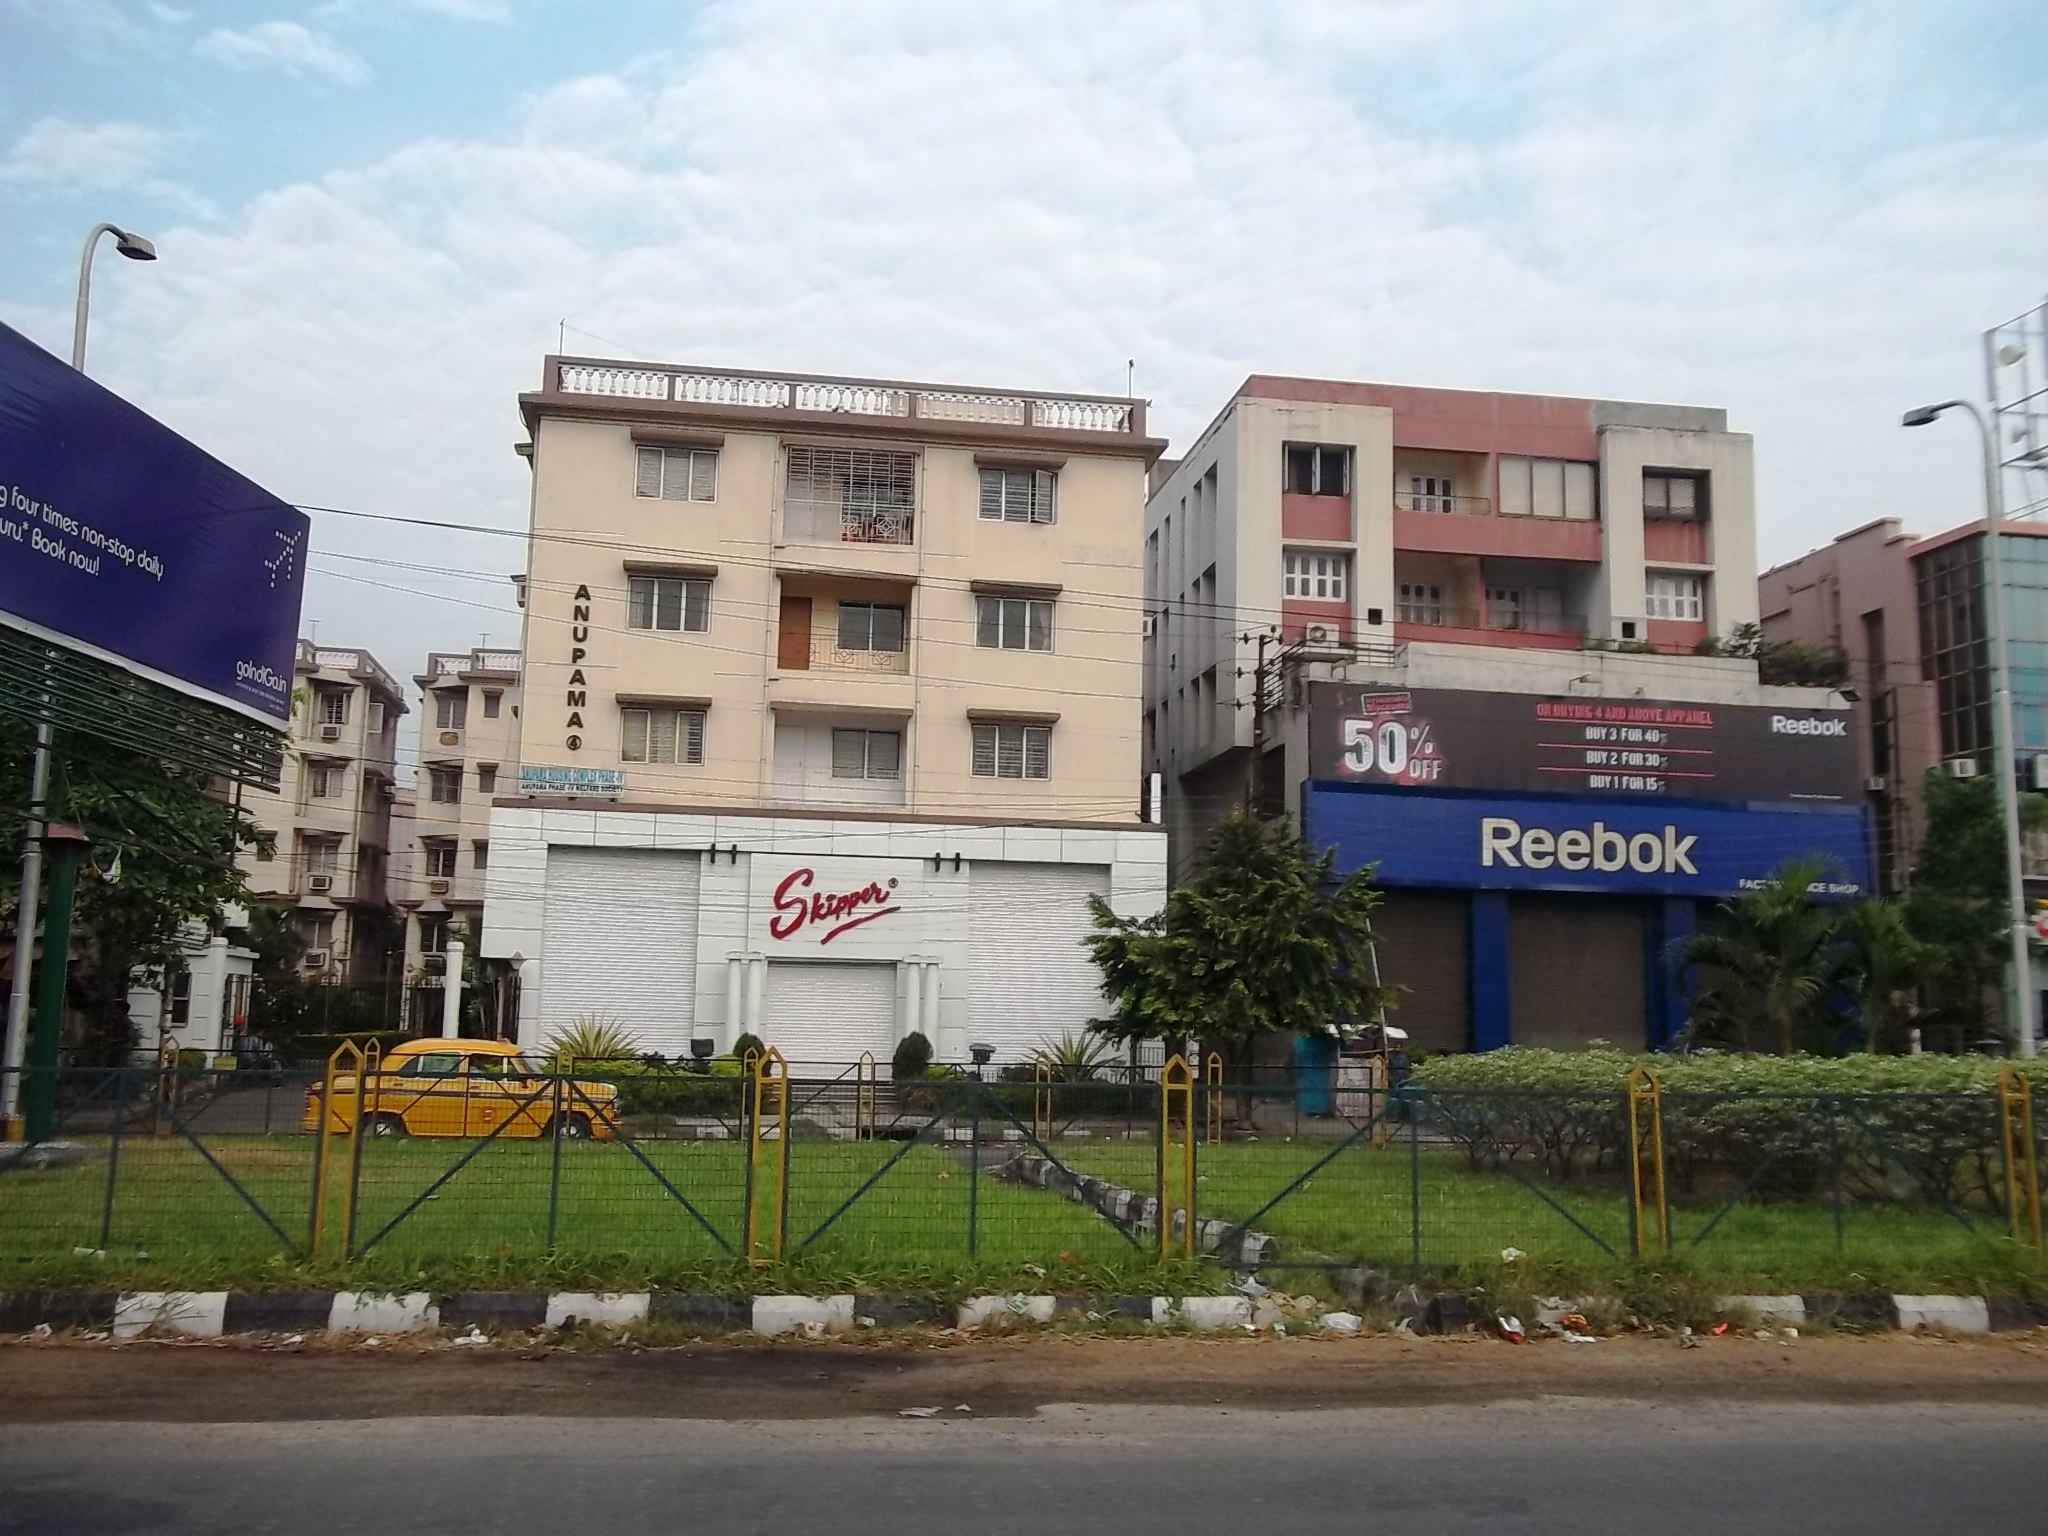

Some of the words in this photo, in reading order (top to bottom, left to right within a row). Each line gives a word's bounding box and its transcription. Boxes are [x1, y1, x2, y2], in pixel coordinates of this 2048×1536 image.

[11, 486, 40, 517] four
[43, 503, 79, 536] times
[81, 526, 135, 566] non-stop
[137, 550, 164, 582] daily
[31, 527, 67, 561] Book
[69, 550, 100, 576] now!
[566, 584, 592, 729] ANUPAMA
[1553, 704, 1592, 718] BUYING
[1604, 706, 1626, 720] AND
[1628, 707, 1663, 721] ABOVE
[1665, 709, 1713, 723] APPAREL
[1585, 726, 1608, 740] BUY
[1609, 727, 1617, 741] 3
[1620, 728, 1643, 742] FOR
[1771, 715, 1848, 736] Reebok
[1586, 751, 1608, 764] BUY
[1610, 751, 1618, 765] 2
[1621, 752, 1644, 766] FOR
[1408, 758, 1443, 781] OFF
[576, 784, 600, 792] WELFARE
[1589, 775, 1611, 789] BUY
[1612, 775, 1619, 789] 1
[1622, 776, 1644, 790] FOR
[1481, 817, 1699, 875] Reebok
[1828, 883, 1860, 894] SHOP
[770, 868, 890, 939] Skipper
